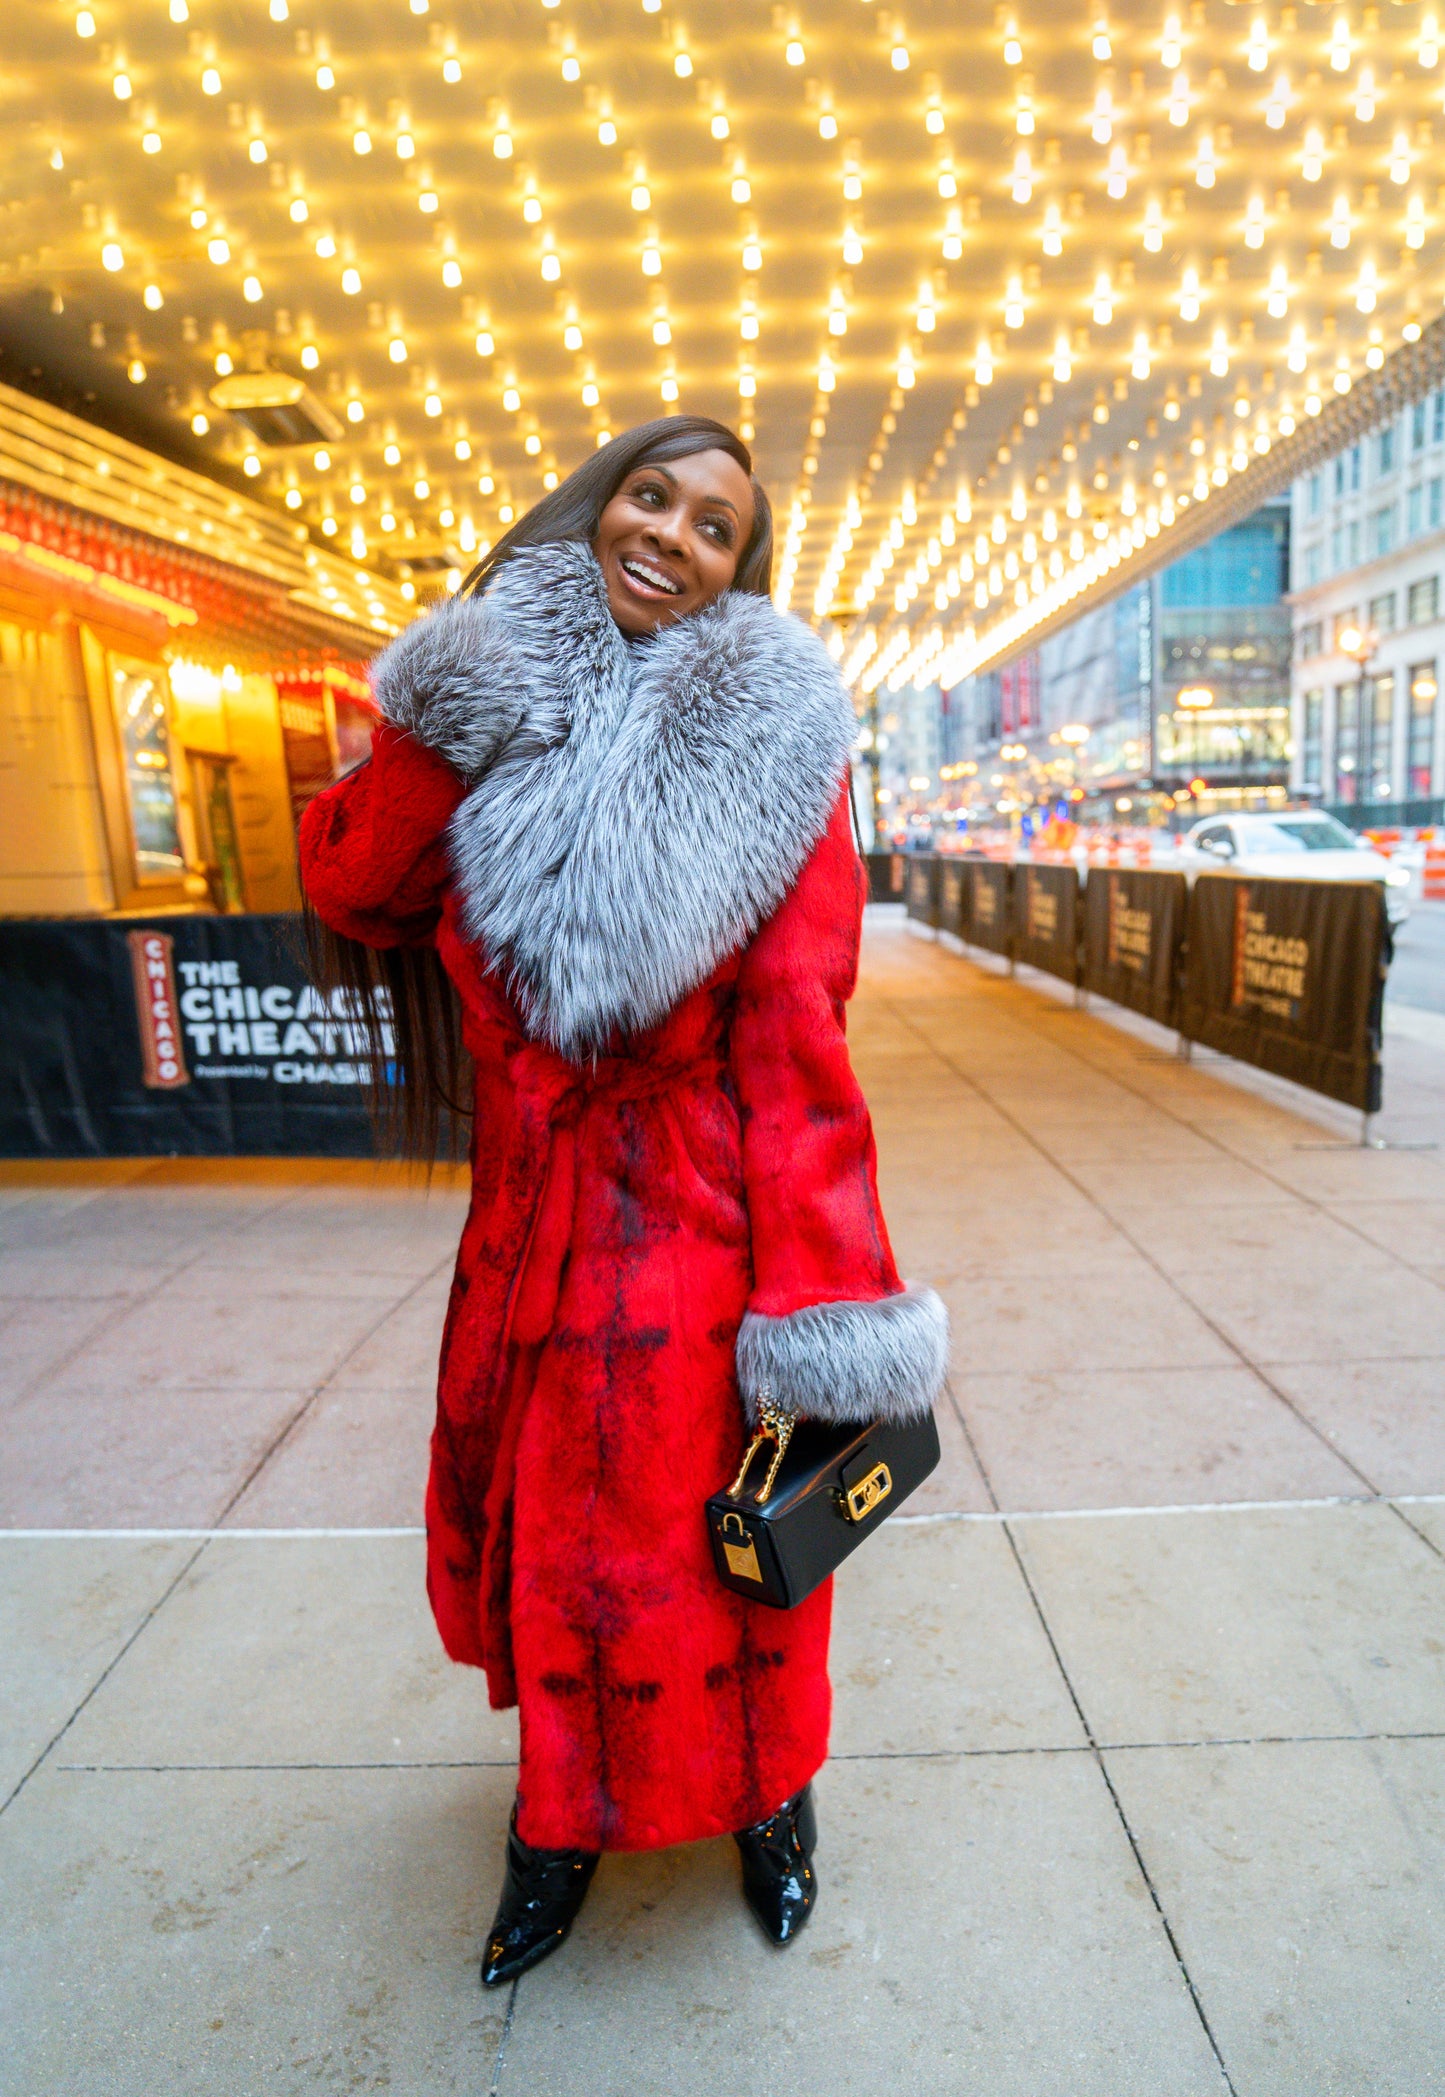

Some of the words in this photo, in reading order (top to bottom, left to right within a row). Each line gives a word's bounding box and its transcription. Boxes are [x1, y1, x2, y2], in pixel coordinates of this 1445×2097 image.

[179, 961, 240, 987] THE
[144, 939, 178, 1081] CHICAGO
[273, 1062, 373, 1084] CHASE
